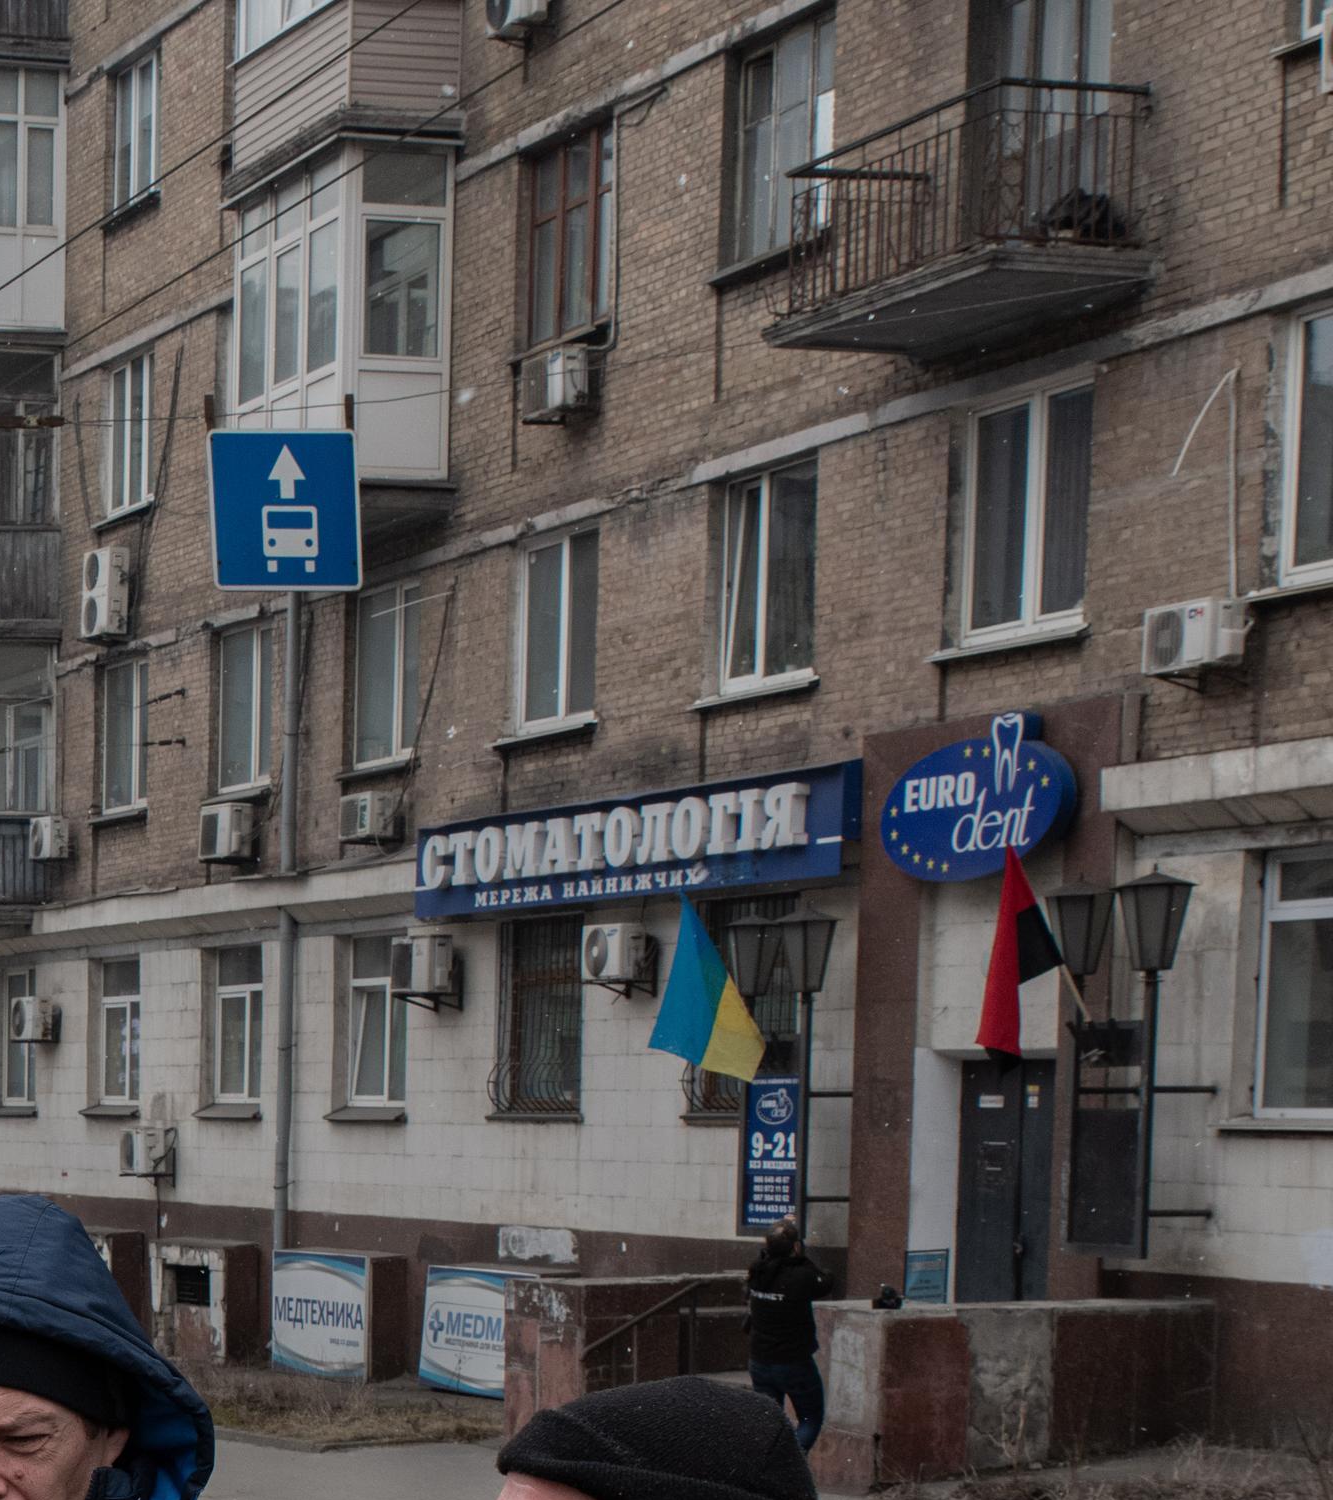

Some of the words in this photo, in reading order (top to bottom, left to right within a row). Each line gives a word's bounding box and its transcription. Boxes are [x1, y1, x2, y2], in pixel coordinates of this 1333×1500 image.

[903, 771, 976, 813] EURO
[421, 781, 811, 890] СТОМАТОЛОГІЯ
[951, 784, 1036, 854] dent
[474, 884, 553, 908] МЕРЕЖА
[562, 868, 703, 898] НАЙНИЖЧИХ
[751, 1131, 796, 1159] 9-21
[274, 1296, 364, 1330] МЕДТЕХНИКА
